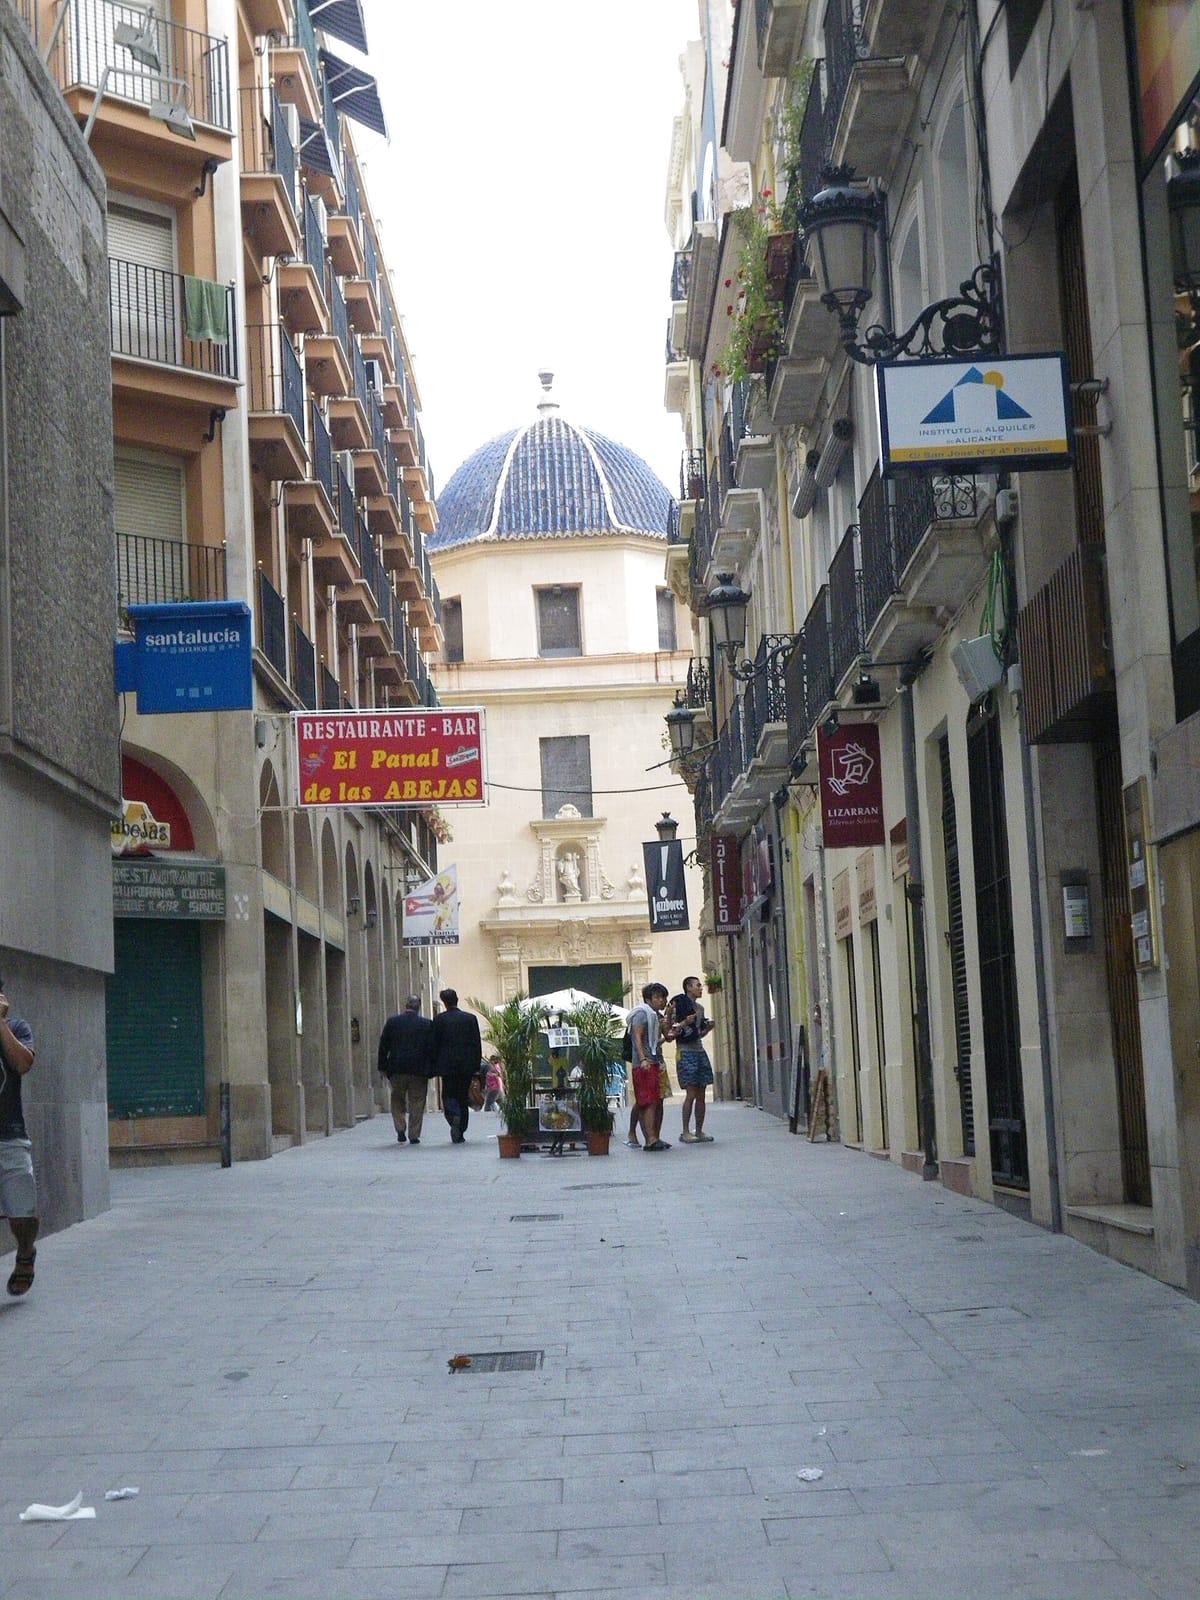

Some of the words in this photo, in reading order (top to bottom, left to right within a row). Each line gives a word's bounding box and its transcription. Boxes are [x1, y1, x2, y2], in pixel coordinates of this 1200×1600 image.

[919, 427, 971, 436] INSTITUTO
[985, 424, 1036, 433] ALQUILER
[955, 434, 1005, 444] ALICANTE
[302, 719, 426, 740] RESTAURANTE
[442, 717, 477, 736] BAR
[332, 750, 357, 770] El
[371, 748, 439, 769] Panal
[304, 783, 332, 801] de
[339, 782, 372, 800] las
[384, 778, 478, 799] ABEJAS
[827, 807, 879, 817] LIZARRAN
